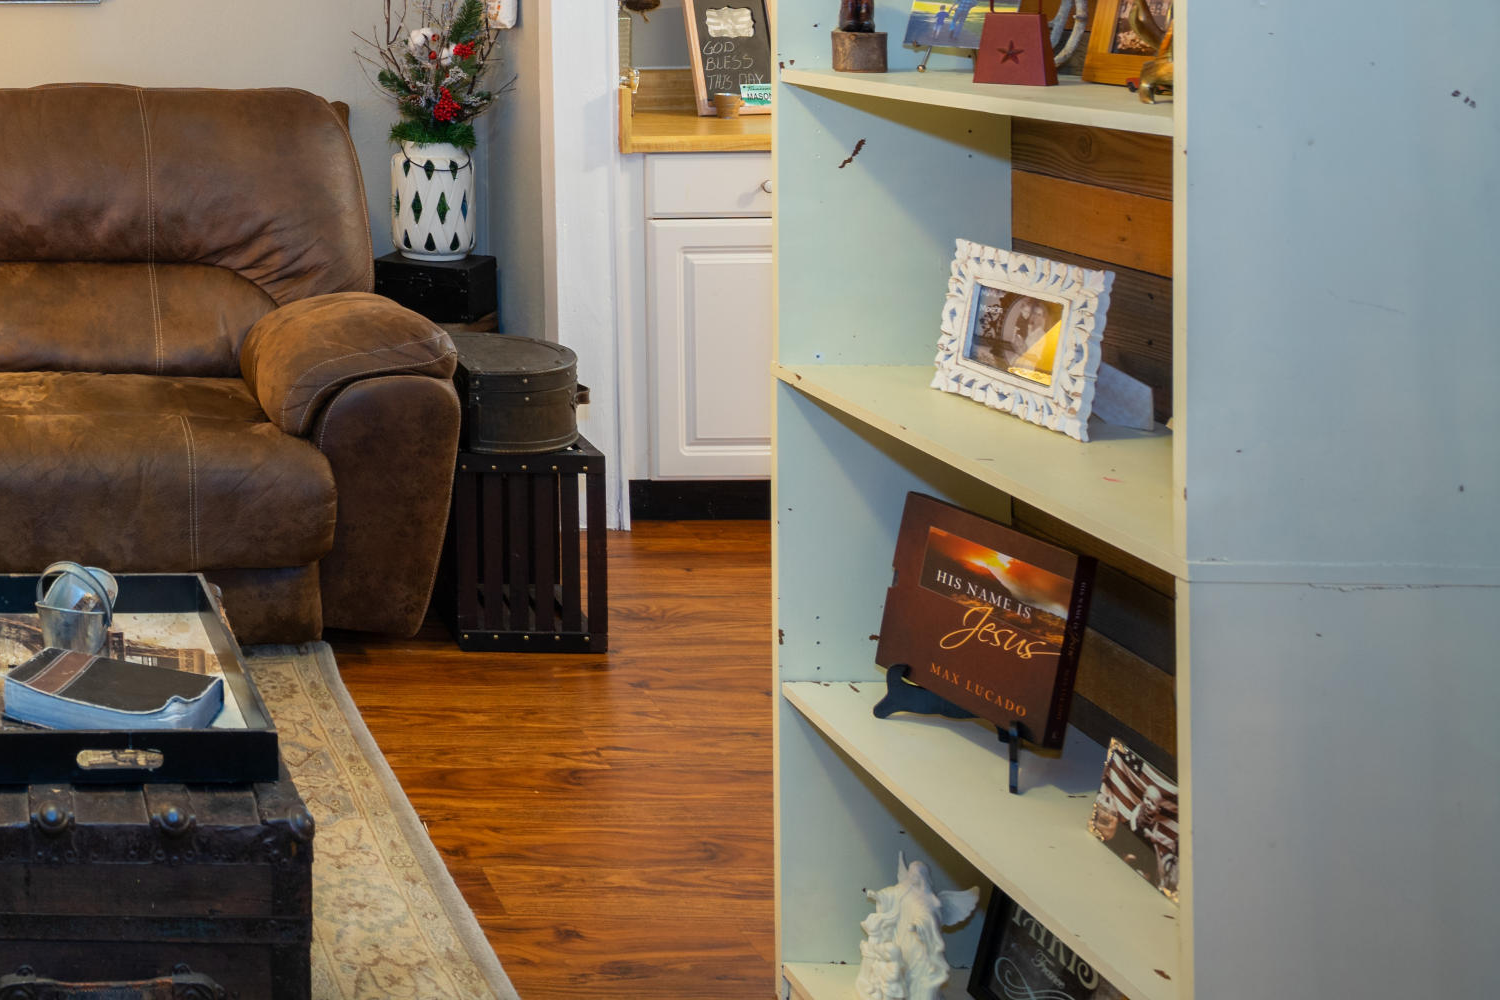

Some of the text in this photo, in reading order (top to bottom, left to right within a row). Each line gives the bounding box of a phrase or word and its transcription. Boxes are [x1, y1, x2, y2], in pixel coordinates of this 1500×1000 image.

[703, 40, 735, 55] GOD
[706, 55, 754, 71] BLESS
[707, 74, 733, 90] THIS
[936, 569, 1032, 619] HIS NAME IS
[939, 606, 1061, 659] Jesus
[929, 662, 960, 685] MAX
[965, 679, 1027, 718] LUCADO
